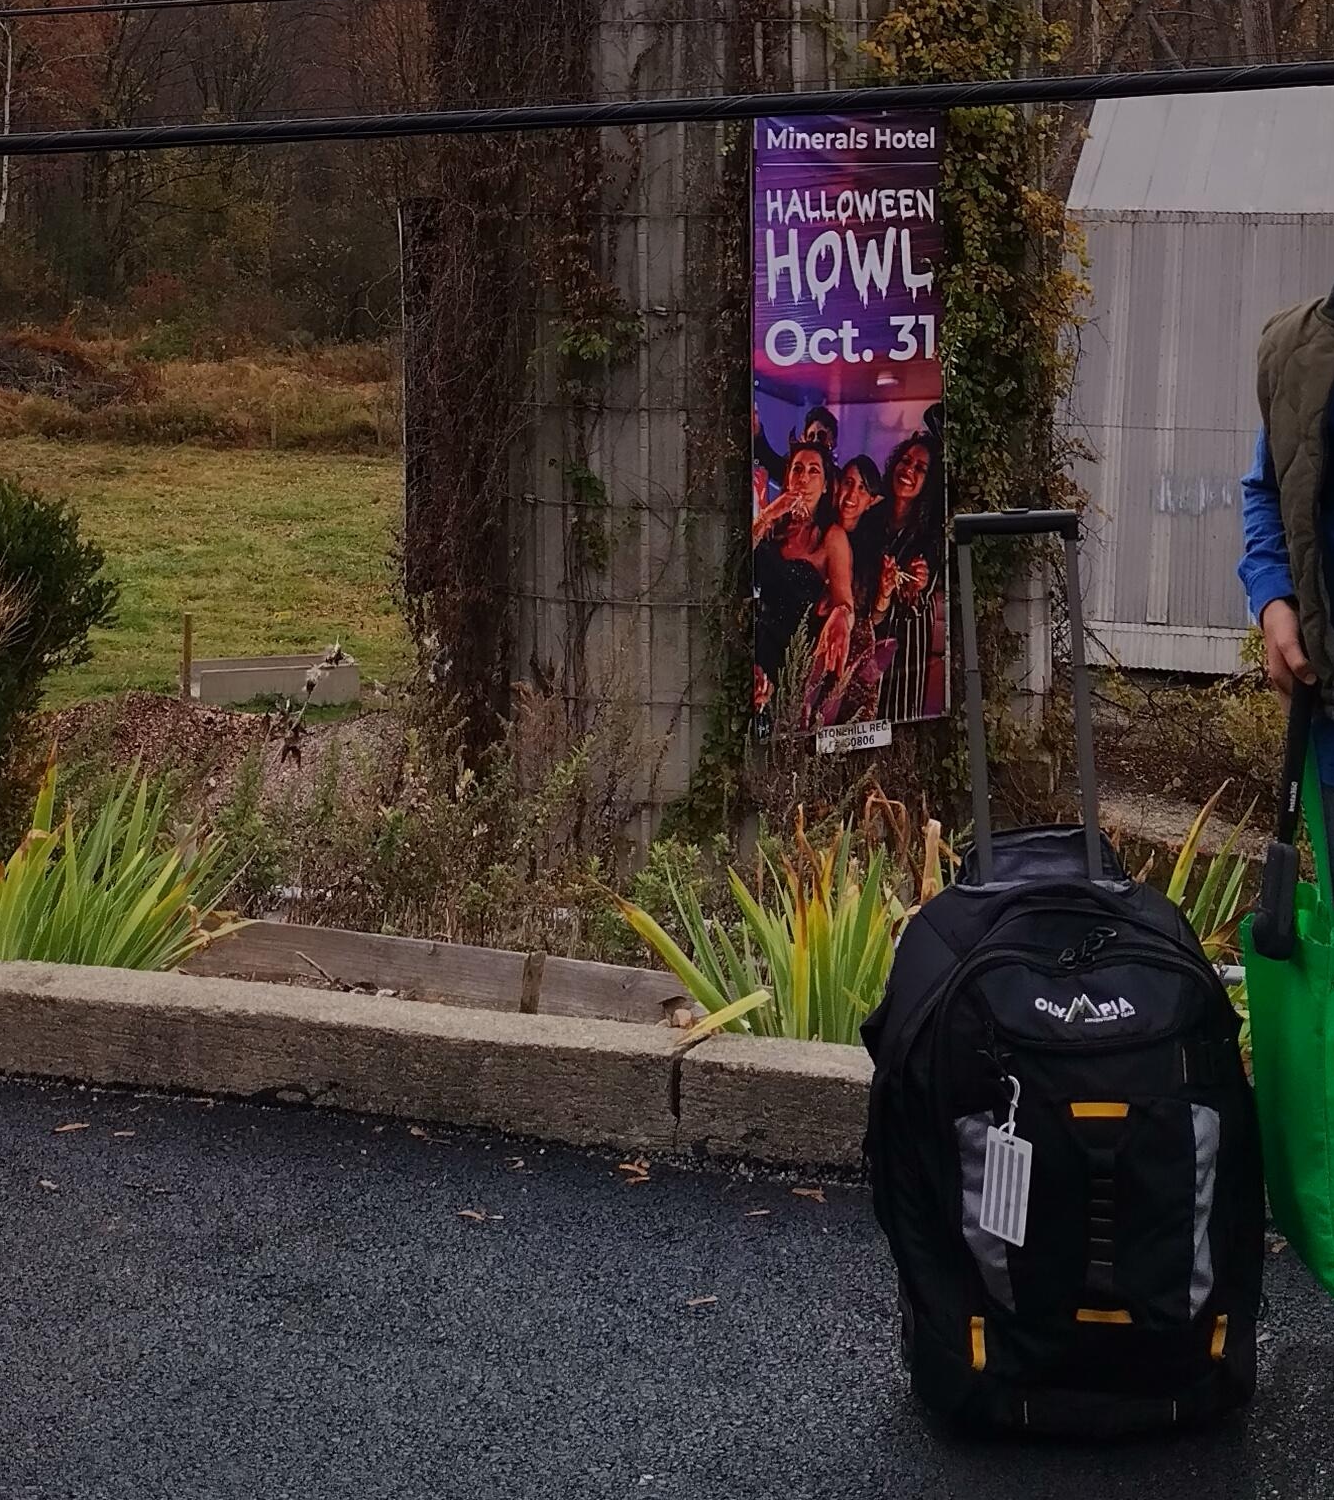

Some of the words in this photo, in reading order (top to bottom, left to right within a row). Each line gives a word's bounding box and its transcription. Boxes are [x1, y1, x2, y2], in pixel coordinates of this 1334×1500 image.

[767, 127, 868, 149] Minerals
[875, 127, 935, 149] Hotel
[767, 189, 935, 225] HALLOWEEN
[766, 227, 934, 314] HOWL
[765, 319, 874, 366] Oct.
[889, 315, 936, 361] 31
